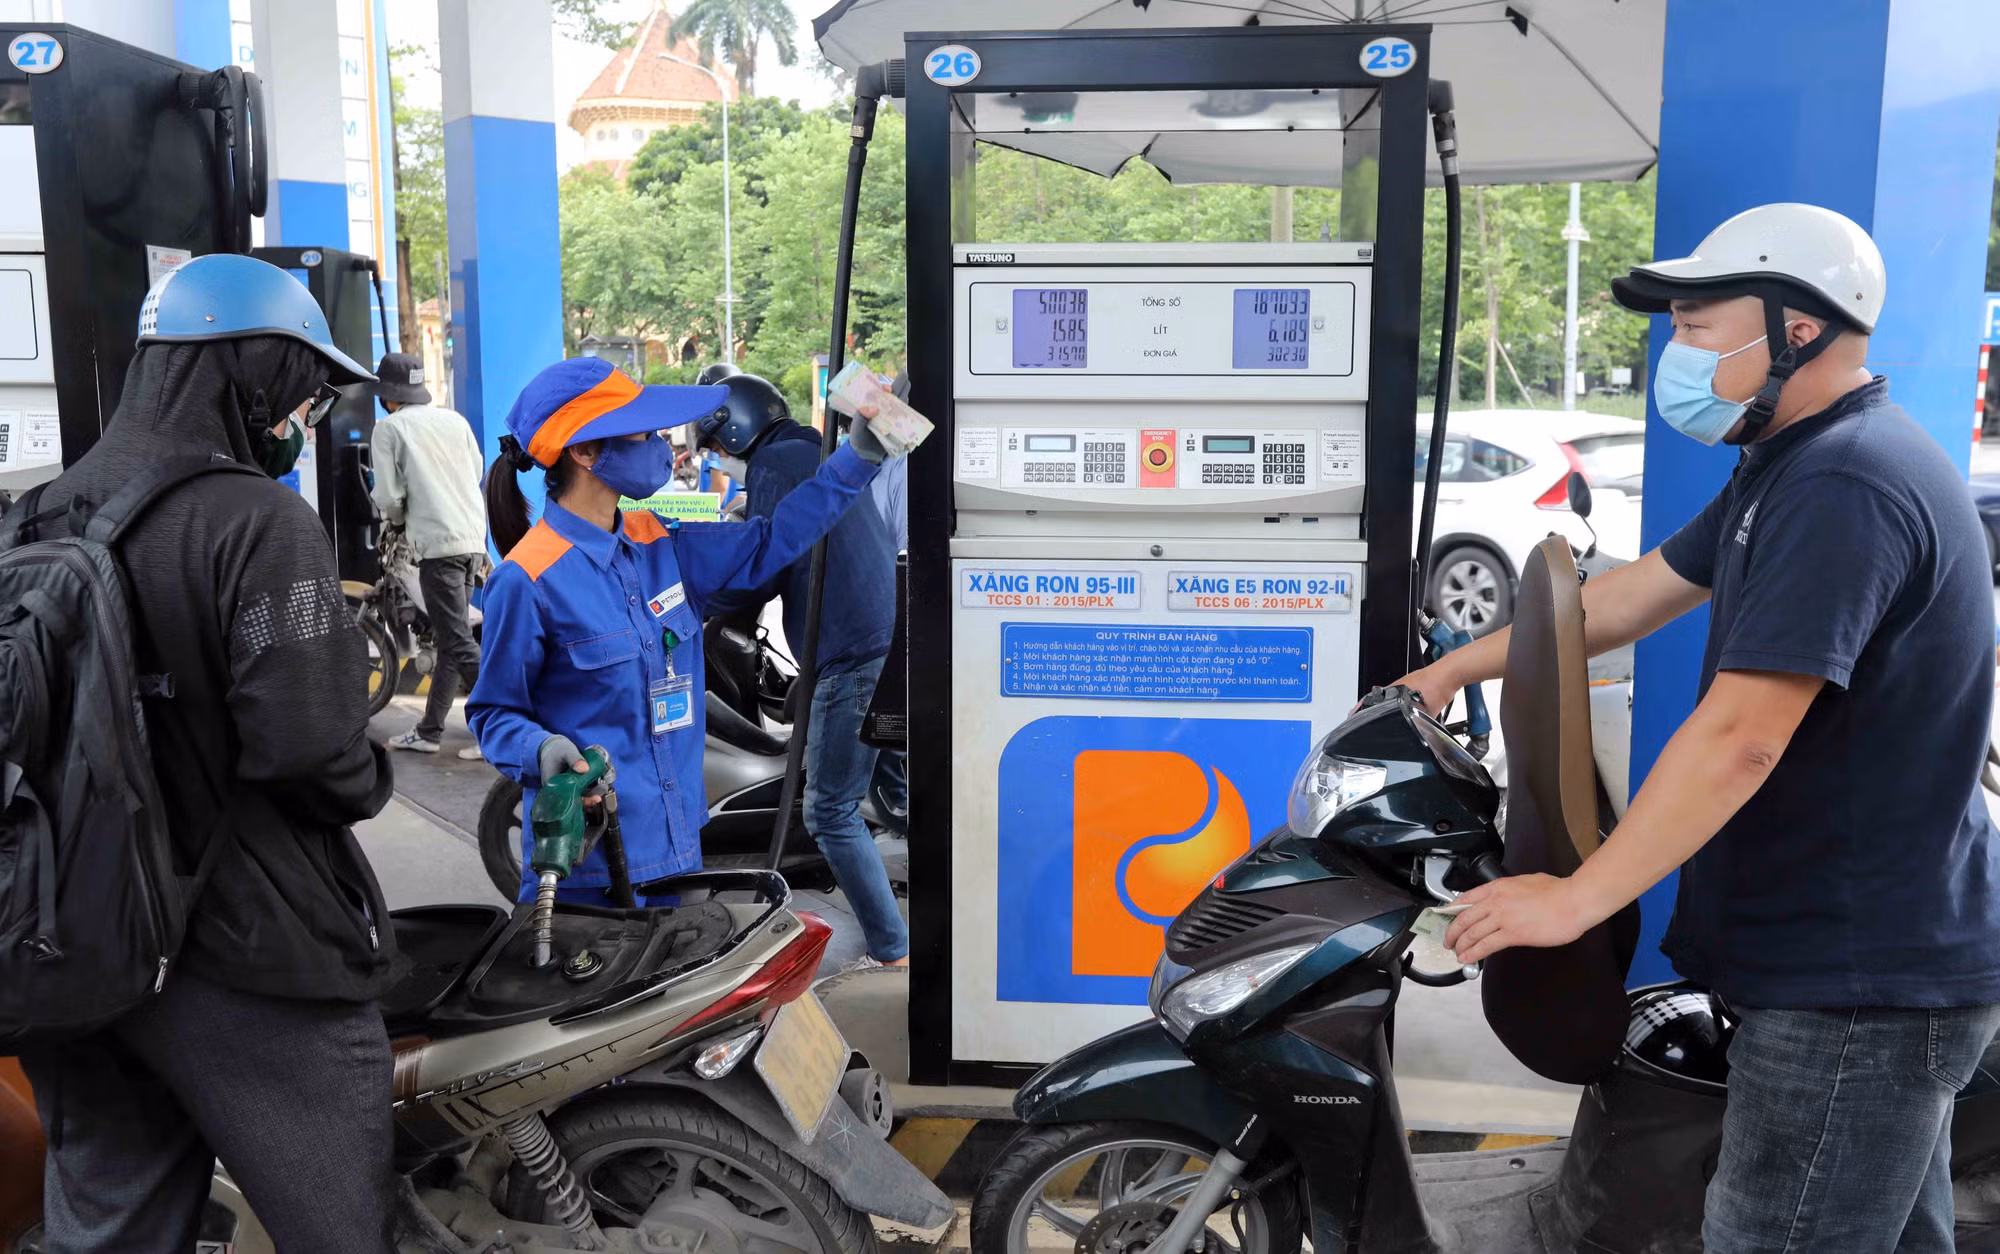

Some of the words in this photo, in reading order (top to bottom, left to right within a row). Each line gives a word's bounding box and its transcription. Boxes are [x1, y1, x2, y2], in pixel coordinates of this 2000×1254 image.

[16, 42, 56, 64] 27
[1368, 44, 1410, 68] 25
[932, 53, 974, 78] 26
[969, 254, 1012, 262] TATSUNO
[1040, 292, 1086, 314] 50038
[1169, 296, 1181, 306] SỐ
[1154, 324, 1168, 334] LÍT
[1143, 349, 1162, 357] ĐƠN
[1163, 348, 1177, 357] GIÁ
[1267, 347, 1306, 361] 30230
[969, 572, 1028, 593] XĂNG
[1036, 576, 1078, 593] RON
[1086, 577, 1135, 594] 95-III
[1176, 576, 1229, 594] XĂNG
[1236, 579, 1256, 594] E5
[1262, 579, 1300, 594] RON
[1307, 580, 1345, 594] 92-II
[987, 594, 1022, 606] TCCS
[1026, 595, 1040, 606] 01
[1053, 596, 1114, 607] 2015/PLX
[1194, 596, 1229, 607] TCCS
[1234, 597, 1250, 608] 06
[1262, 598, 1324, 608] 2015/PLX
[1096, 632, 1120, 640] QUY
[1122, 632, 1156, 640] TRÌNH
[1293, 1095, 1361, 1104] HONDA
